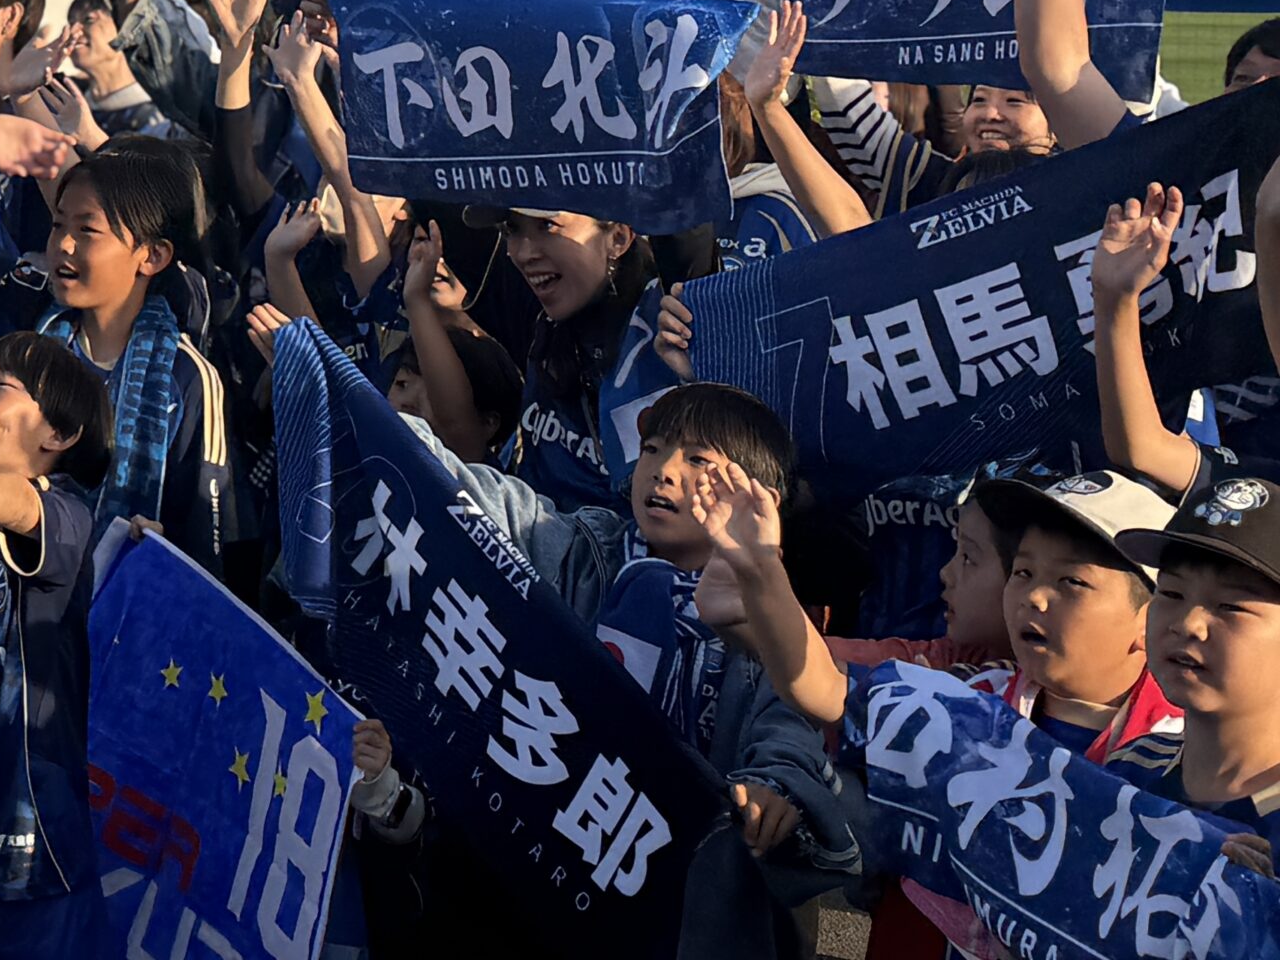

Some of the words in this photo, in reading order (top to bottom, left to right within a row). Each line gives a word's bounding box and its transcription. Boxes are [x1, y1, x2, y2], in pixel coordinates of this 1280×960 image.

[898, 45, 923, 65] NA
[934, 42, 984, 62] SANG
[995, 39, 1019, 59] HO
[435, 164, 547, 190] SHIMODA
[961, 185, 1024, 213] MACHIDA
[909, 194, 1033, 250] ZELVIA
[970, 383, 1081, 431] SOMA
[471, 765, 591, 911] KOTARO
